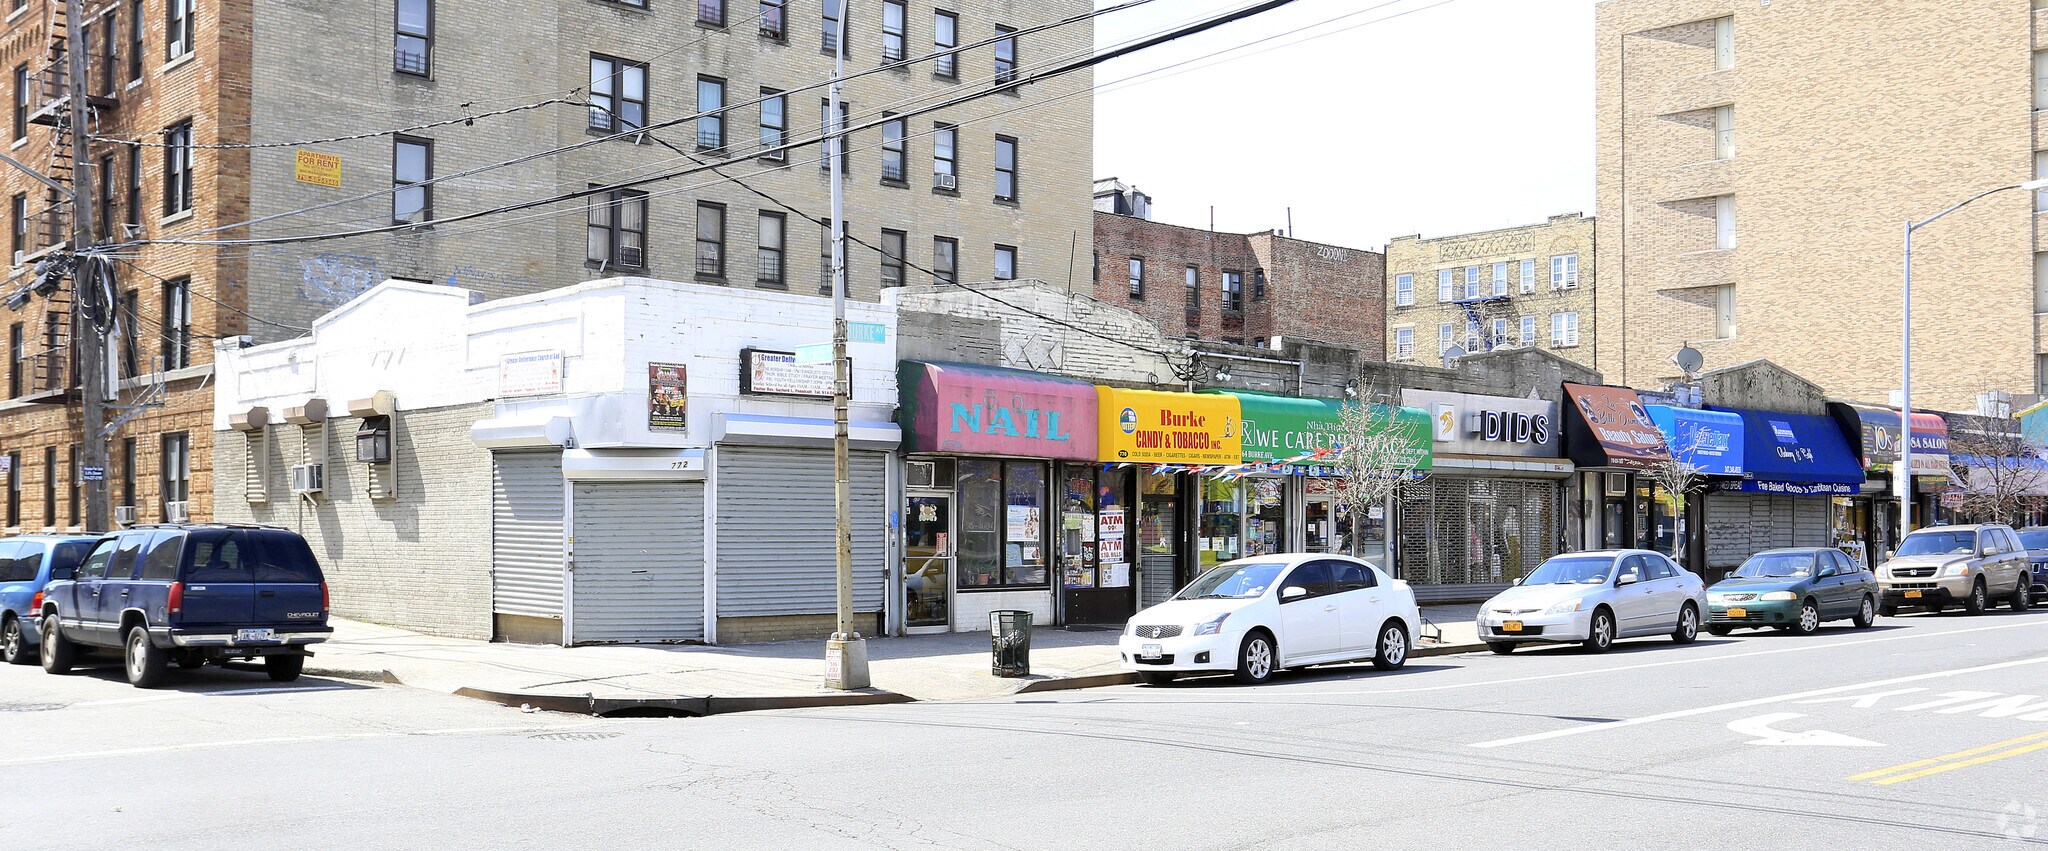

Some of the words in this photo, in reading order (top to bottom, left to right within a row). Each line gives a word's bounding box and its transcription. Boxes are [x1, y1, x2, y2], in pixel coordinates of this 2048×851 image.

[298, 150, 339, 162] APARTMENTS
[298, 156, 315, 165] FOR
[316, 159, 339, 168] RENT
[761, 353, 782, 363] Greater
[782, 355, 796, 363] Deliv
[950, 402, 1070, 441] NAIL
[1160, 409, 1206, 428] Burke
[1483, 410, 1549, 445] DIDS
[1136, 430, 1163, 449] CANDY
[1165, 433, 1171, 449] &
[1172, 432, 1210, 450] TOBACCO
[1256, 429, 1279, 448] WE
[1285, 431, 1323, 450] CARE
[1599, 427, 1634, 445] Beauty
[1629, 429, 1659, 445] Salon
[1910, 436, 1922, 449] SA
[1922, 437, 1948, 450] SALON
[1248, 451, 1264, 459] BURKE
[671, 460, 688, 470] 772
[1768, 481, 1785, 492] Baked
[1832, 483, 1851, 493] Cuisine
[1101, 516, 1123, 525] ATM
[1101, 541, 1121, 552] ATM
[1789, 688, 2048, 721] NLY
